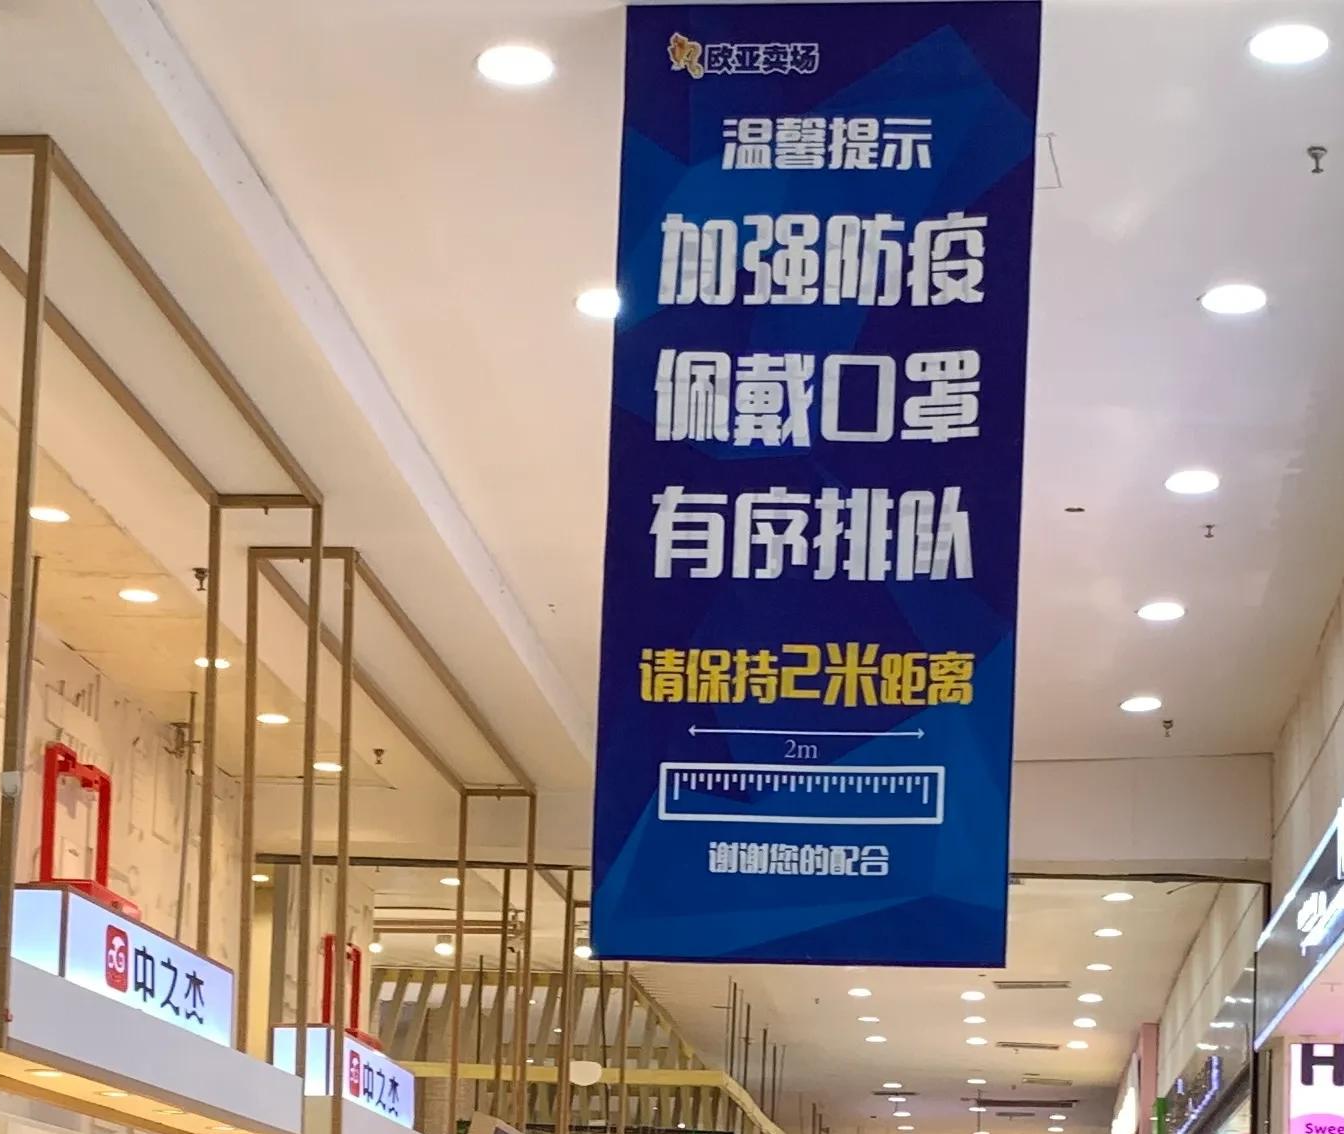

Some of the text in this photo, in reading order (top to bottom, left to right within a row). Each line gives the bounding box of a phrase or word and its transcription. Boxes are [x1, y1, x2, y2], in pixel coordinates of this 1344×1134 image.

[705, 42, 819, 75] 欧亚卖场
[722, 116, 932, 170] 温馨提示
[658, 212, 988, 306] 加强防疫
[654, 348, 981, 447] 佩戴口罩
[650, 486, 974, 581] 有序排队
[639, 642, 975, 707] 请保持2米距离
[784, 738, 818, 760] 2m
[708, 842, 889, 876] 谢谢您的配合
[134, 945, 205, 1025] 中之杰
[363, 1061, 399, 1117] 中之杰
